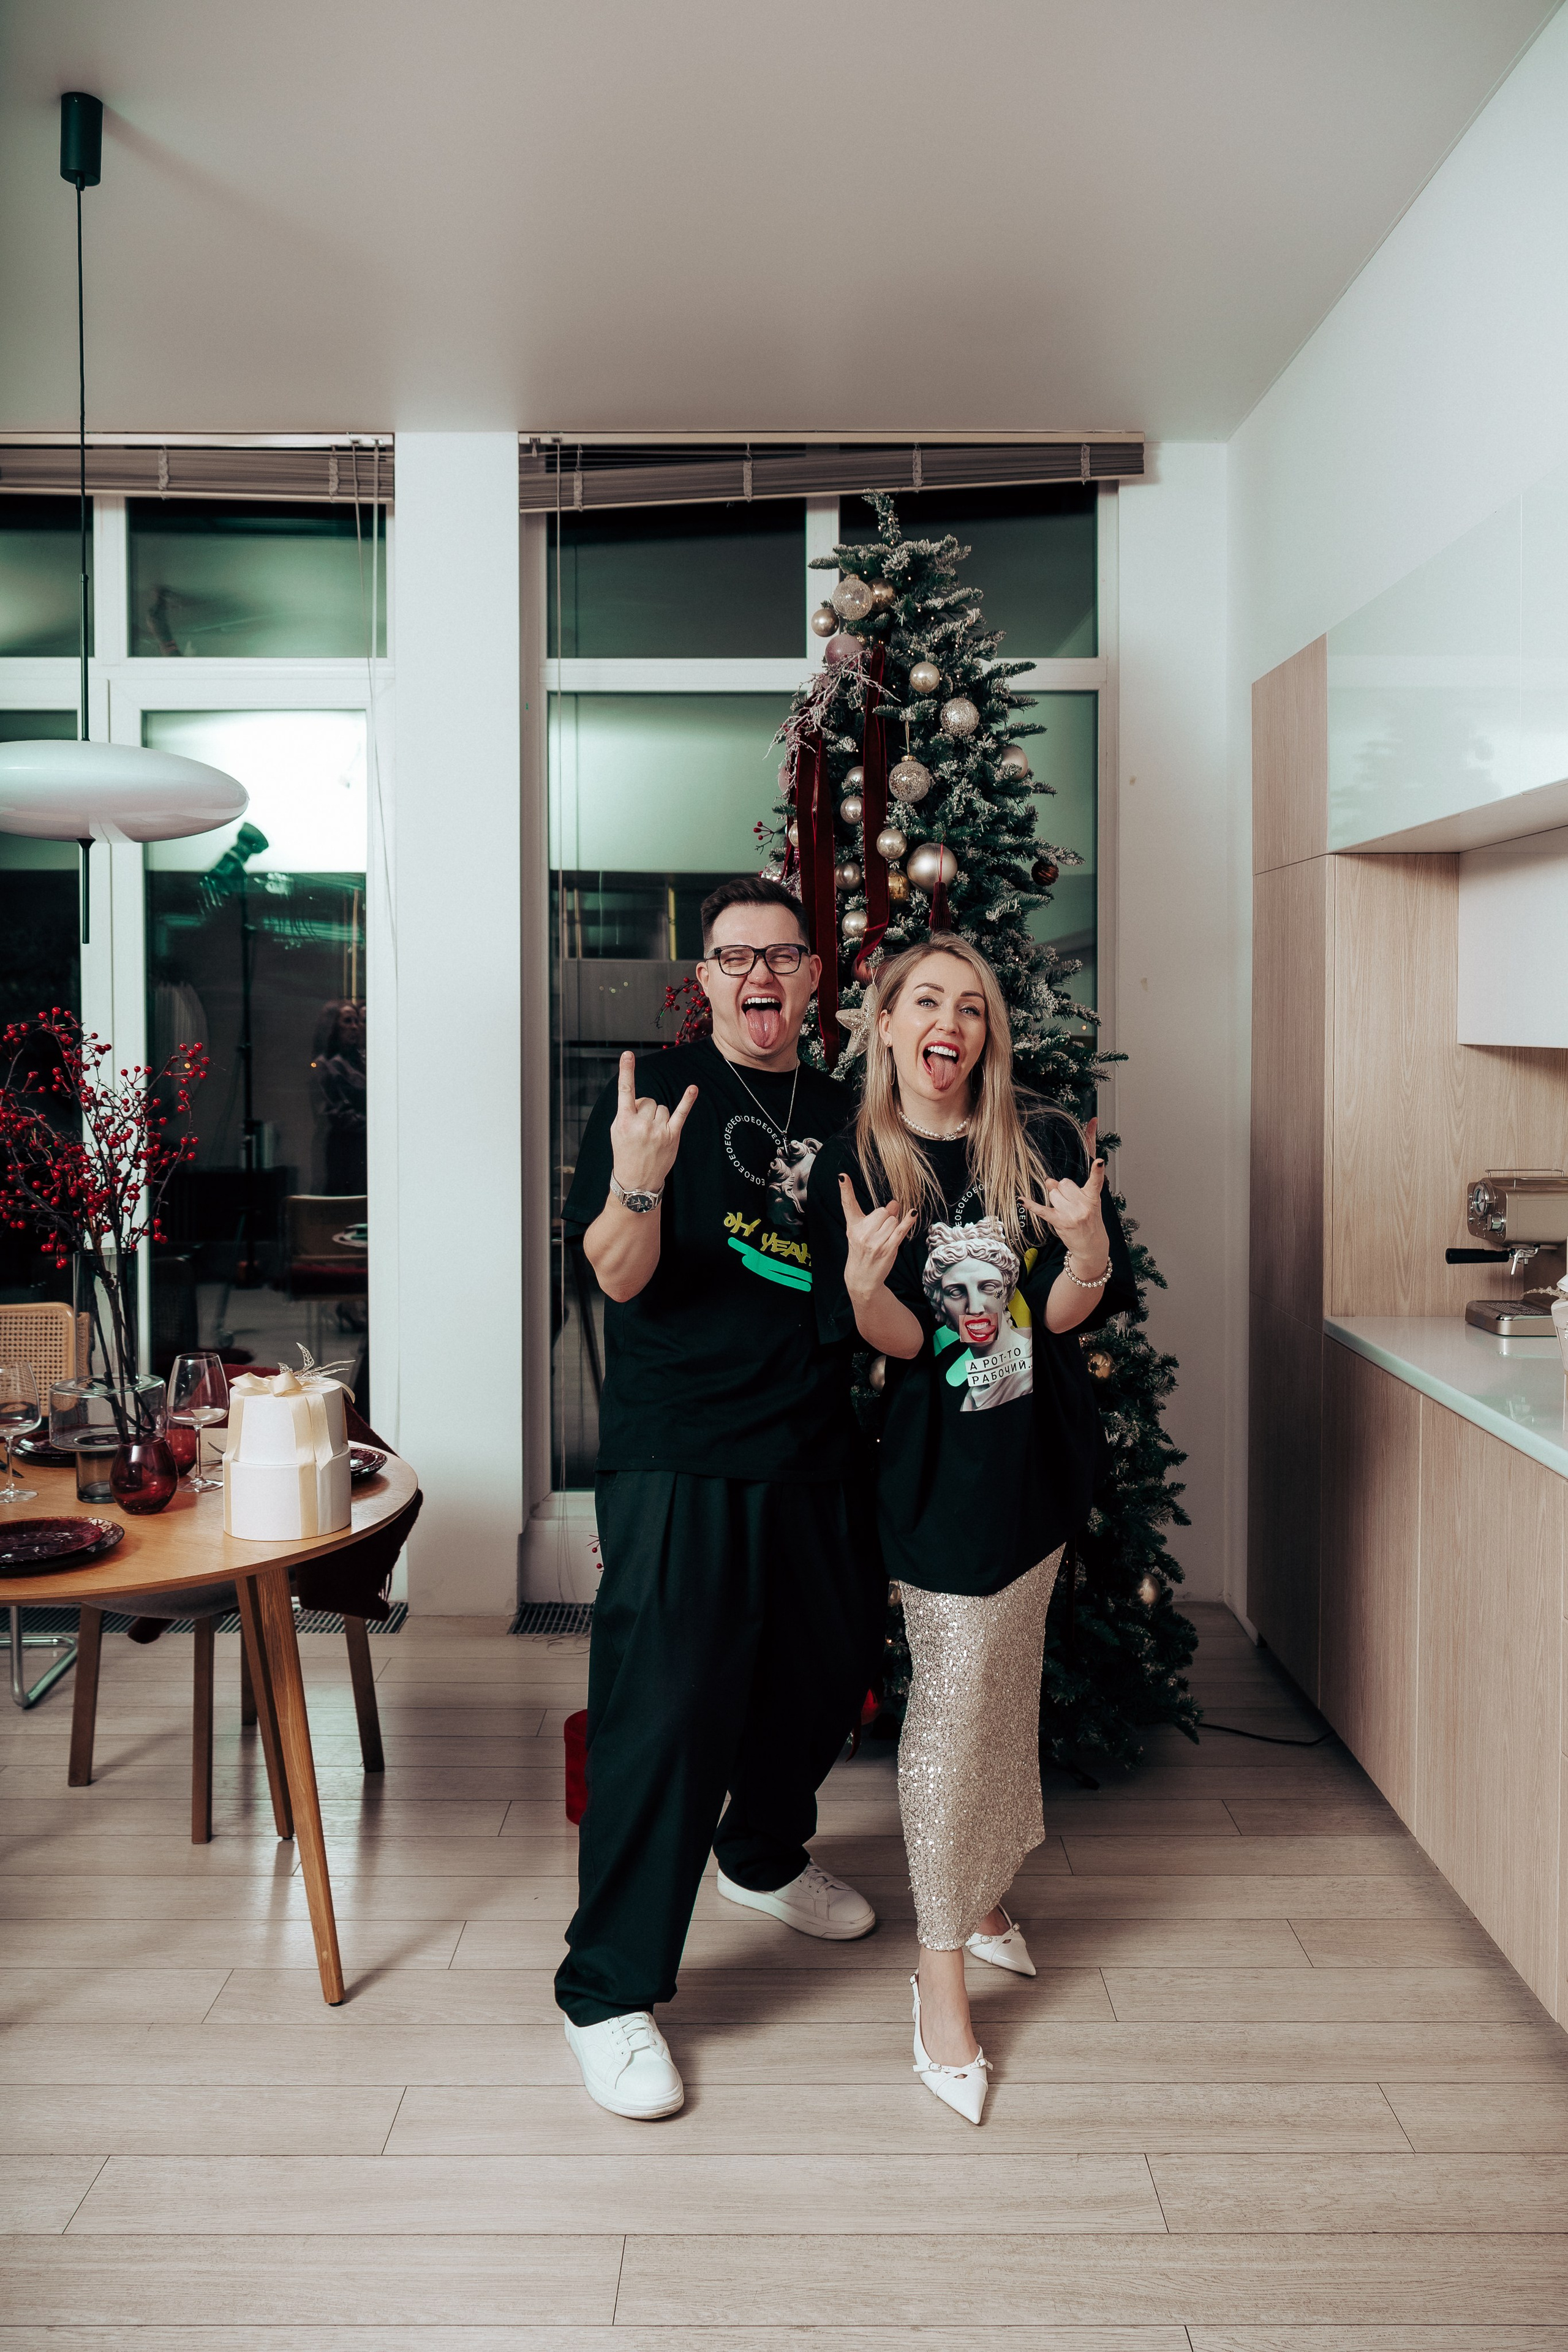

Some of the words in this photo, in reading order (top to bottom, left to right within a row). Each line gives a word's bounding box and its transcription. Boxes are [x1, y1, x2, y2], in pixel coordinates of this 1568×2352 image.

[724, 1212, 761, 1236] OH
[970, 1362, 978, 1371] А
[982, 1348, 1021, 1368] РОТ-ТО
